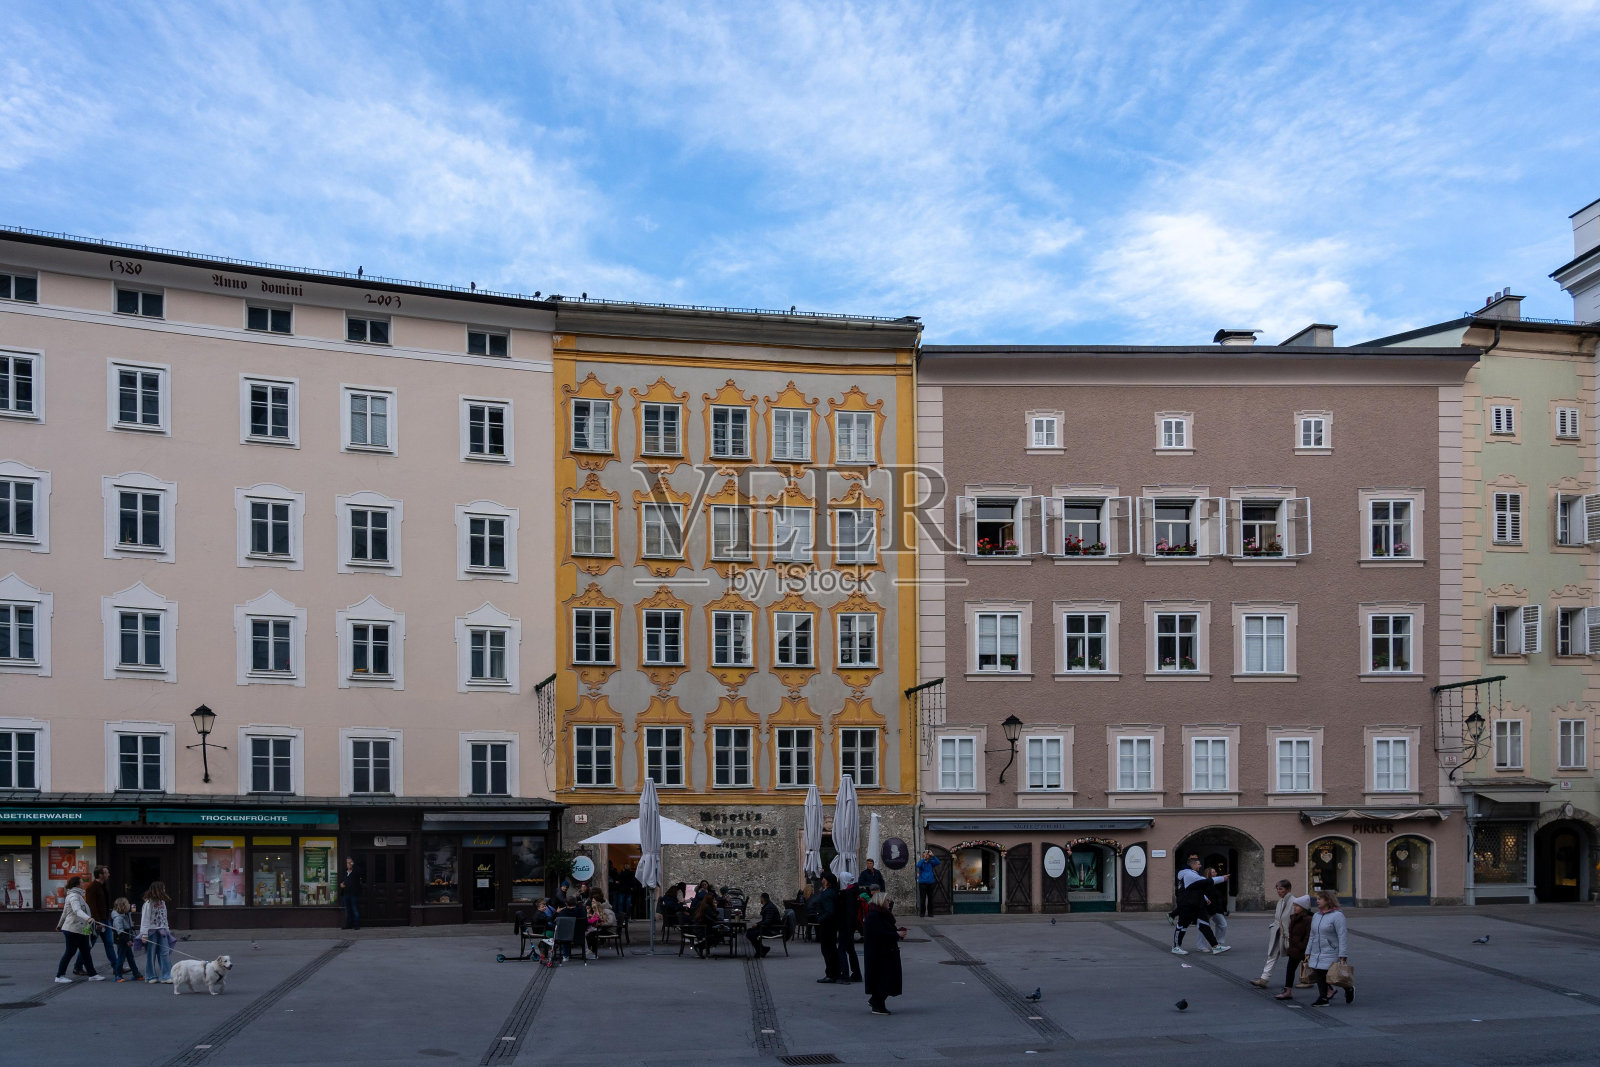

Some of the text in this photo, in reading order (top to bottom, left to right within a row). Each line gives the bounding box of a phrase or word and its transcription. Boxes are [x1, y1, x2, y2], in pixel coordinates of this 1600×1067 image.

[109, 259, 143, 276] 1380
[211, 273, 248, 290] Anno
[200, 814, 288, 822] TROCKENFRÜCHTE
[1352, 823, 1394, 834] PIRKER
